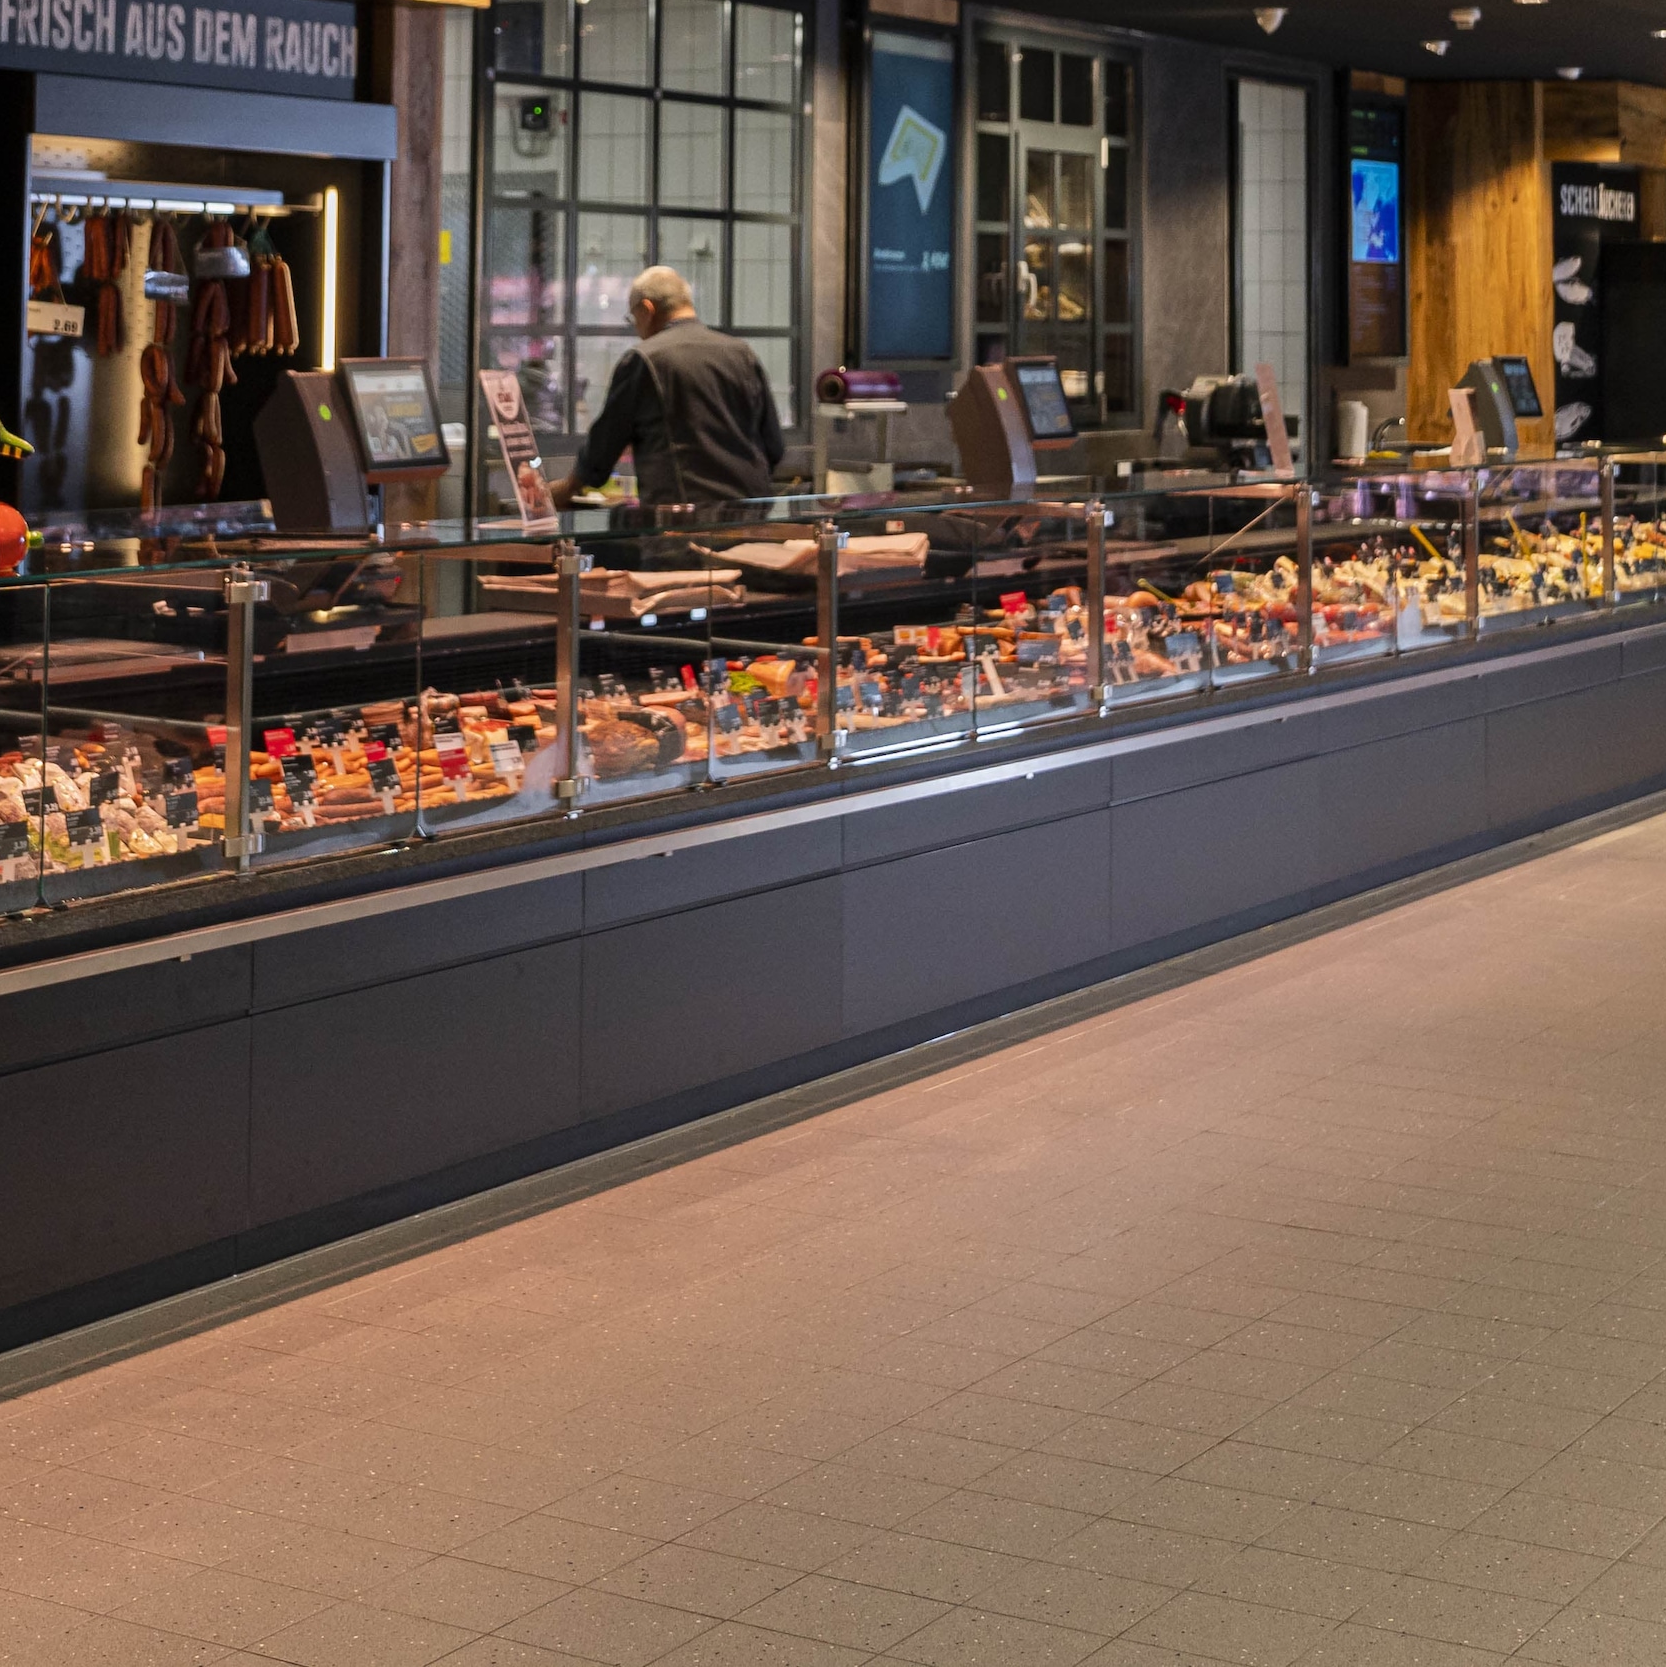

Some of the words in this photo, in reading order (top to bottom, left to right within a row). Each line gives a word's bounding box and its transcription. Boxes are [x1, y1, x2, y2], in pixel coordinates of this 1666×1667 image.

[125, 2, 186, 62] AUS
[193, 8, 258, 69] DEM
[265, 16, 358, 78] RAUCH
